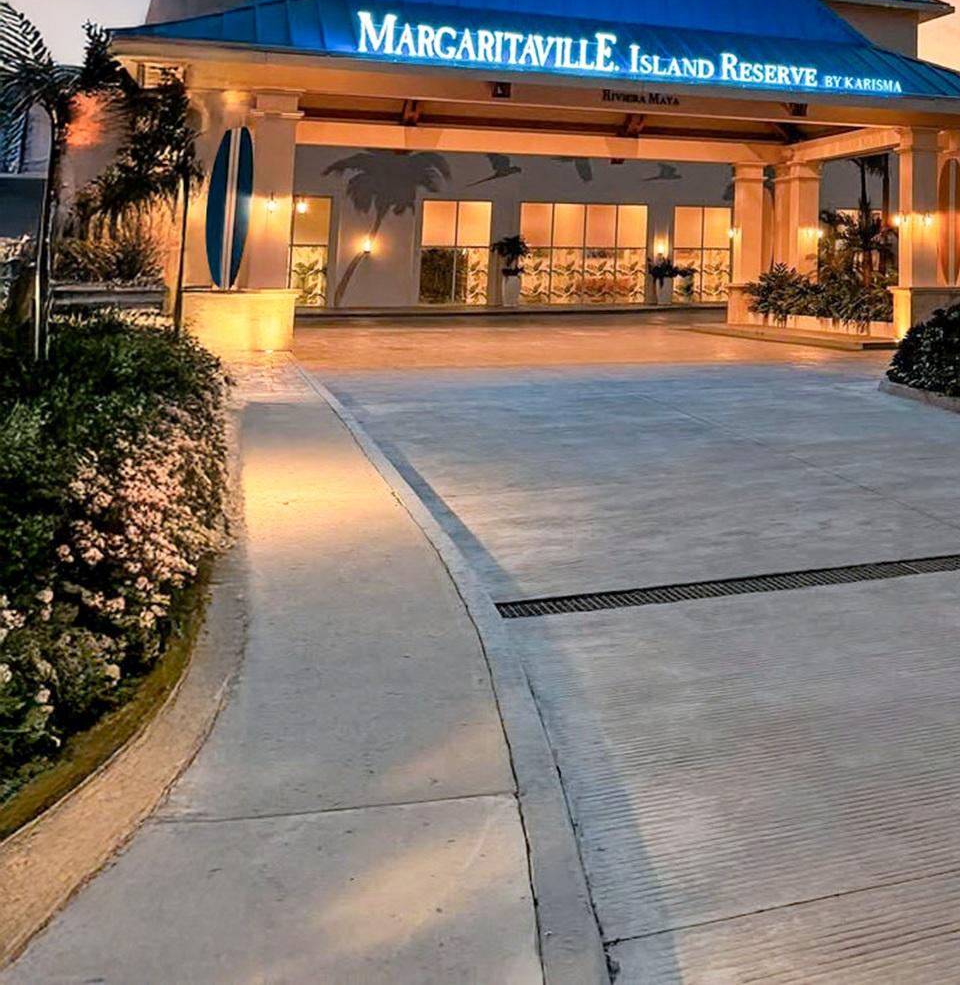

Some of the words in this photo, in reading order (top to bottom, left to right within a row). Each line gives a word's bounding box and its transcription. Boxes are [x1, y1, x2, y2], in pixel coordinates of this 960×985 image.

[629, 44, 716, 80] ISLAND
[720, 52, 818, 87] RESERVE
[825, 75, 842, 88] BY
[844, 76, 903, 93] KARISMA
[648, 93, 680, 105] MAYA
